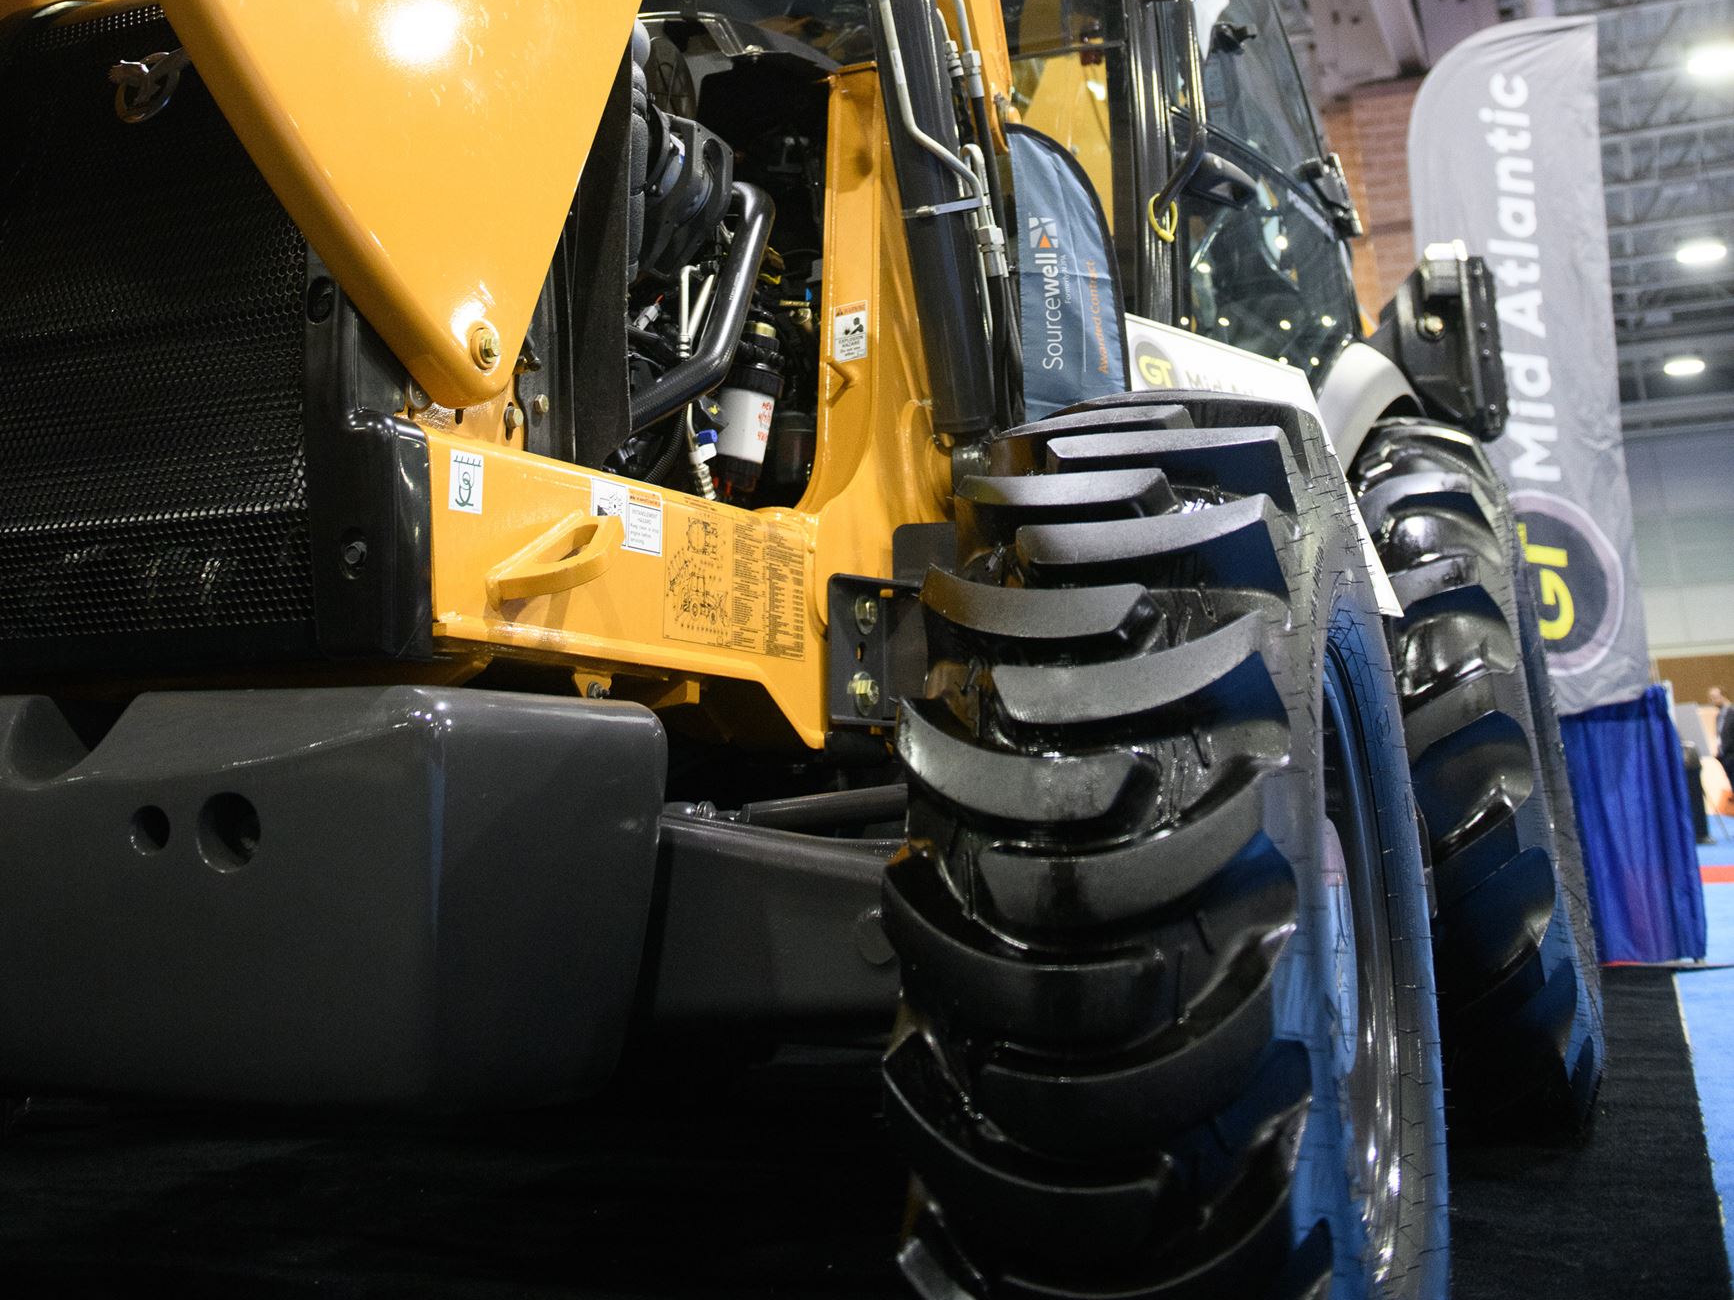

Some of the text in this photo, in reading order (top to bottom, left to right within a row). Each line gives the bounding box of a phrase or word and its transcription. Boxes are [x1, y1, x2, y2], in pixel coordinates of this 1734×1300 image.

[1034, 252, 1064, 371] Sourcewell
[1479, 72, 1562, 482] Mid Atlantic
[1137, 355, 1174, 389] GT
[1516, 522, 1575, 641] GT
